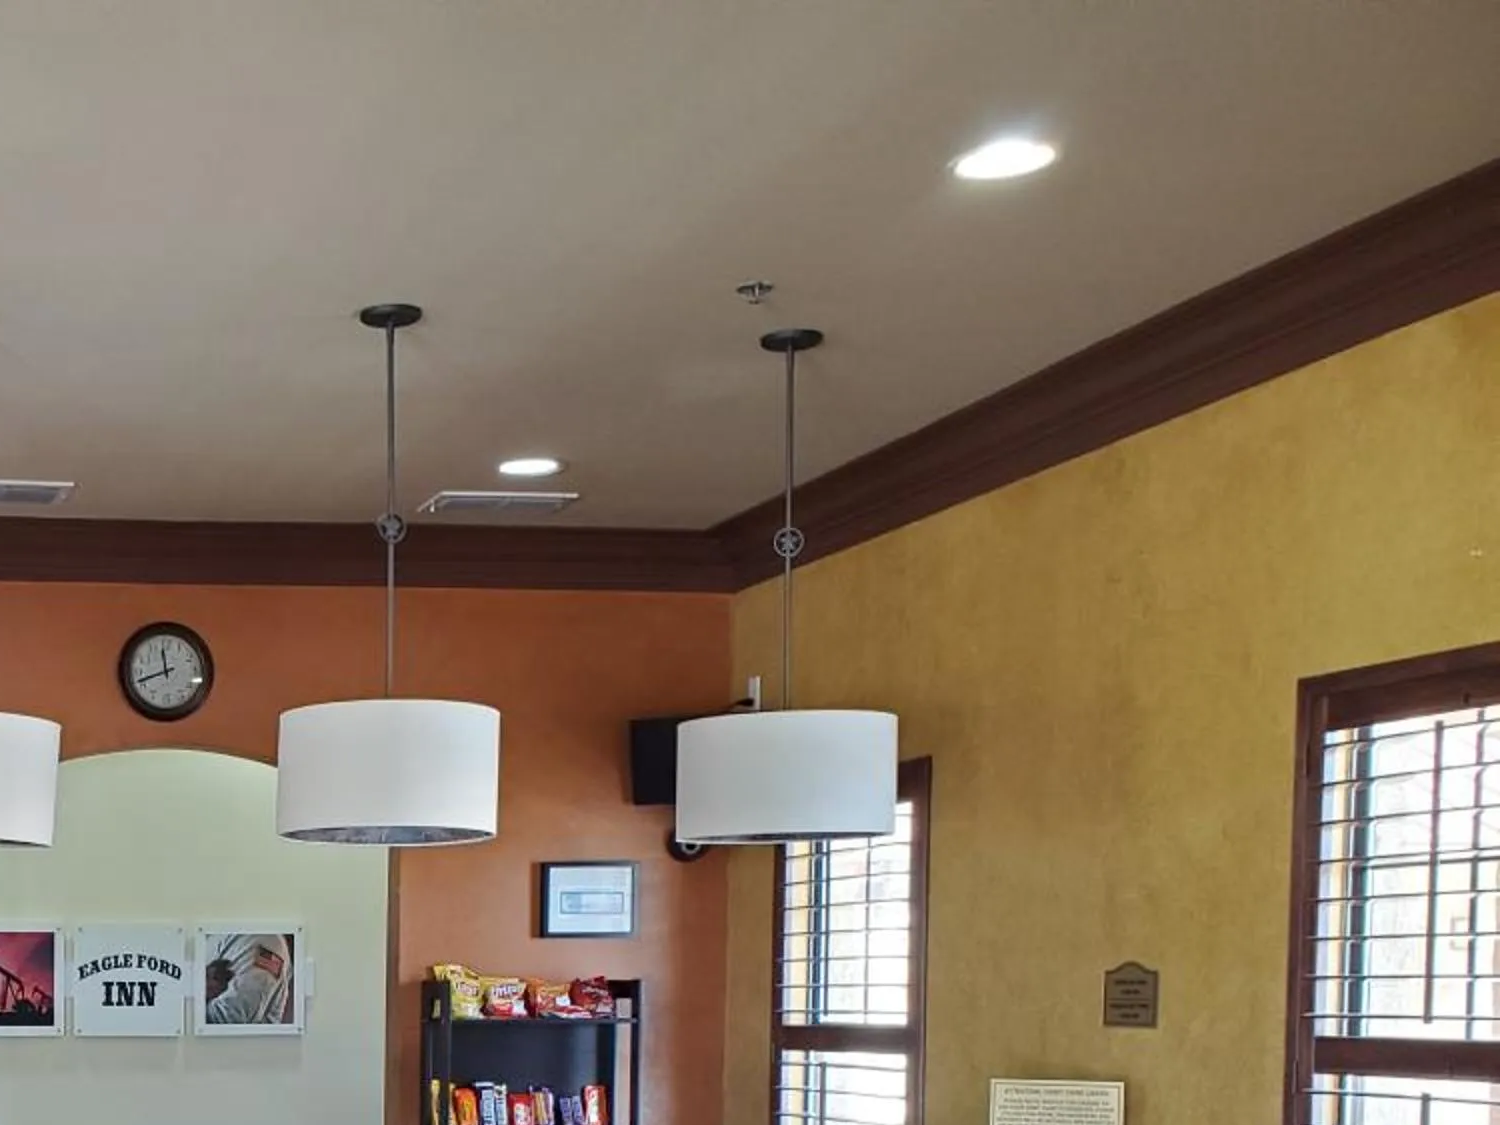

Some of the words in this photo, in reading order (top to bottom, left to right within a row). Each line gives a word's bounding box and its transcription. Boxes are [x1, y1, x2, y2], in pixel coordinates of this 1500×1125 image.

[78, 953, 133, 980] EAGLE
[137, 953, 182, 980] FORD
[102, 981, 157, 1007] INN
